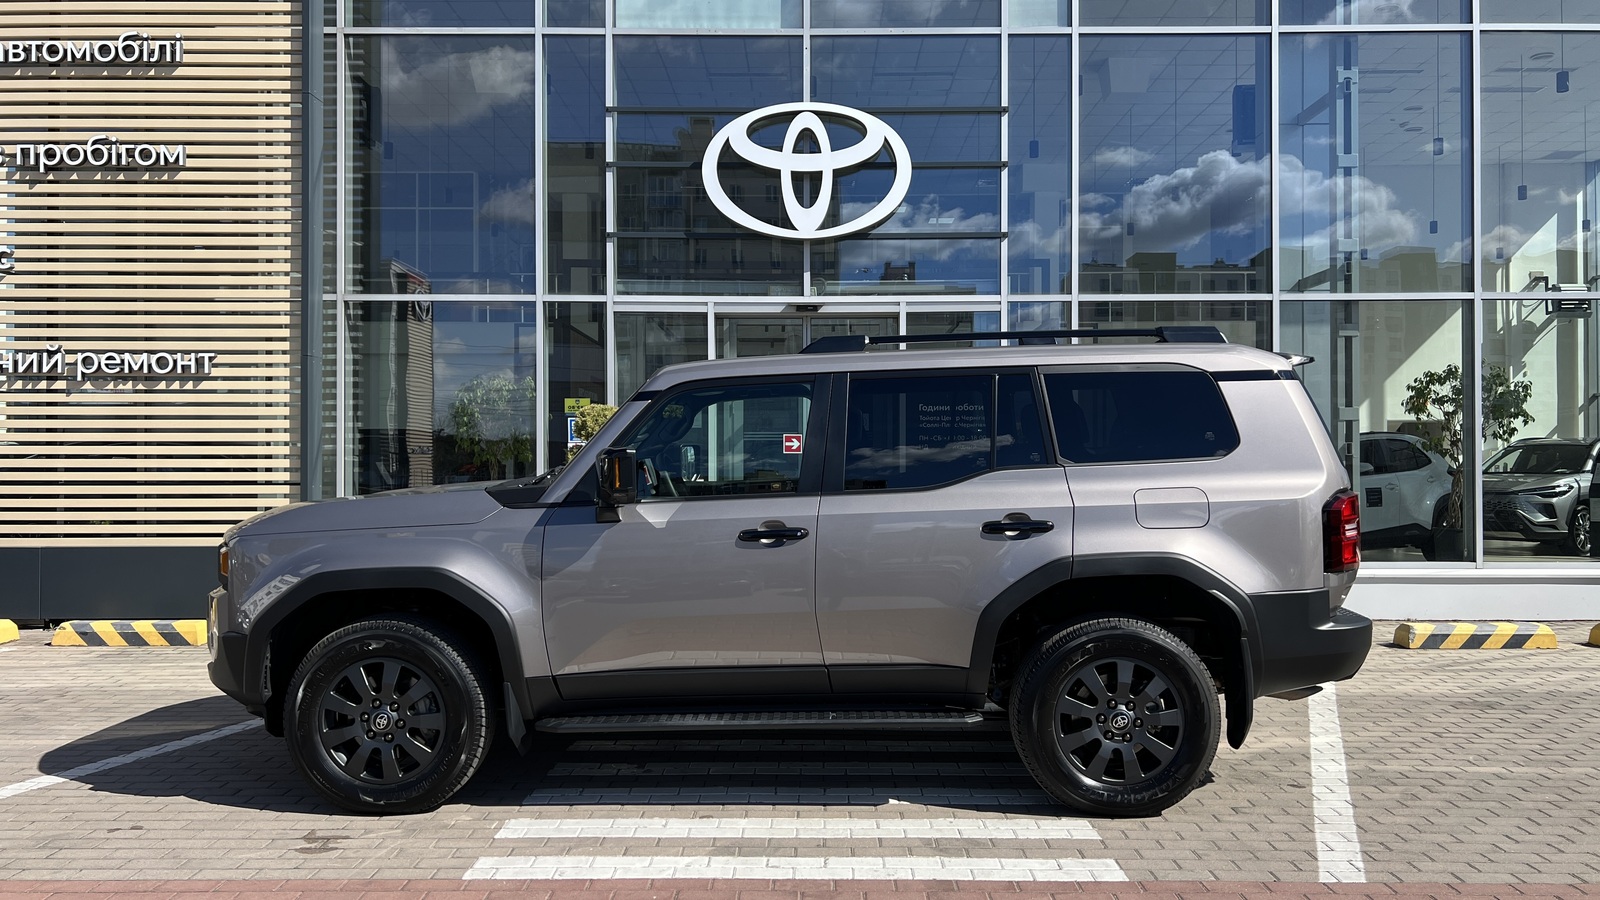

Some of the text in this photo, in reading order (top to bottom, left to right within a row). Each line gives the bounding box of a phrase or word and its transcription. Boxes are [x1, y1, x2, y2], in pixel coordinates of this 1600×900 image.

[0, 31, 183, 63] втомобілі
[15, 135, 186, 172] пробігом
[76, 352, 215, 380] ремонт
[918, 404, 950, 412] Години
